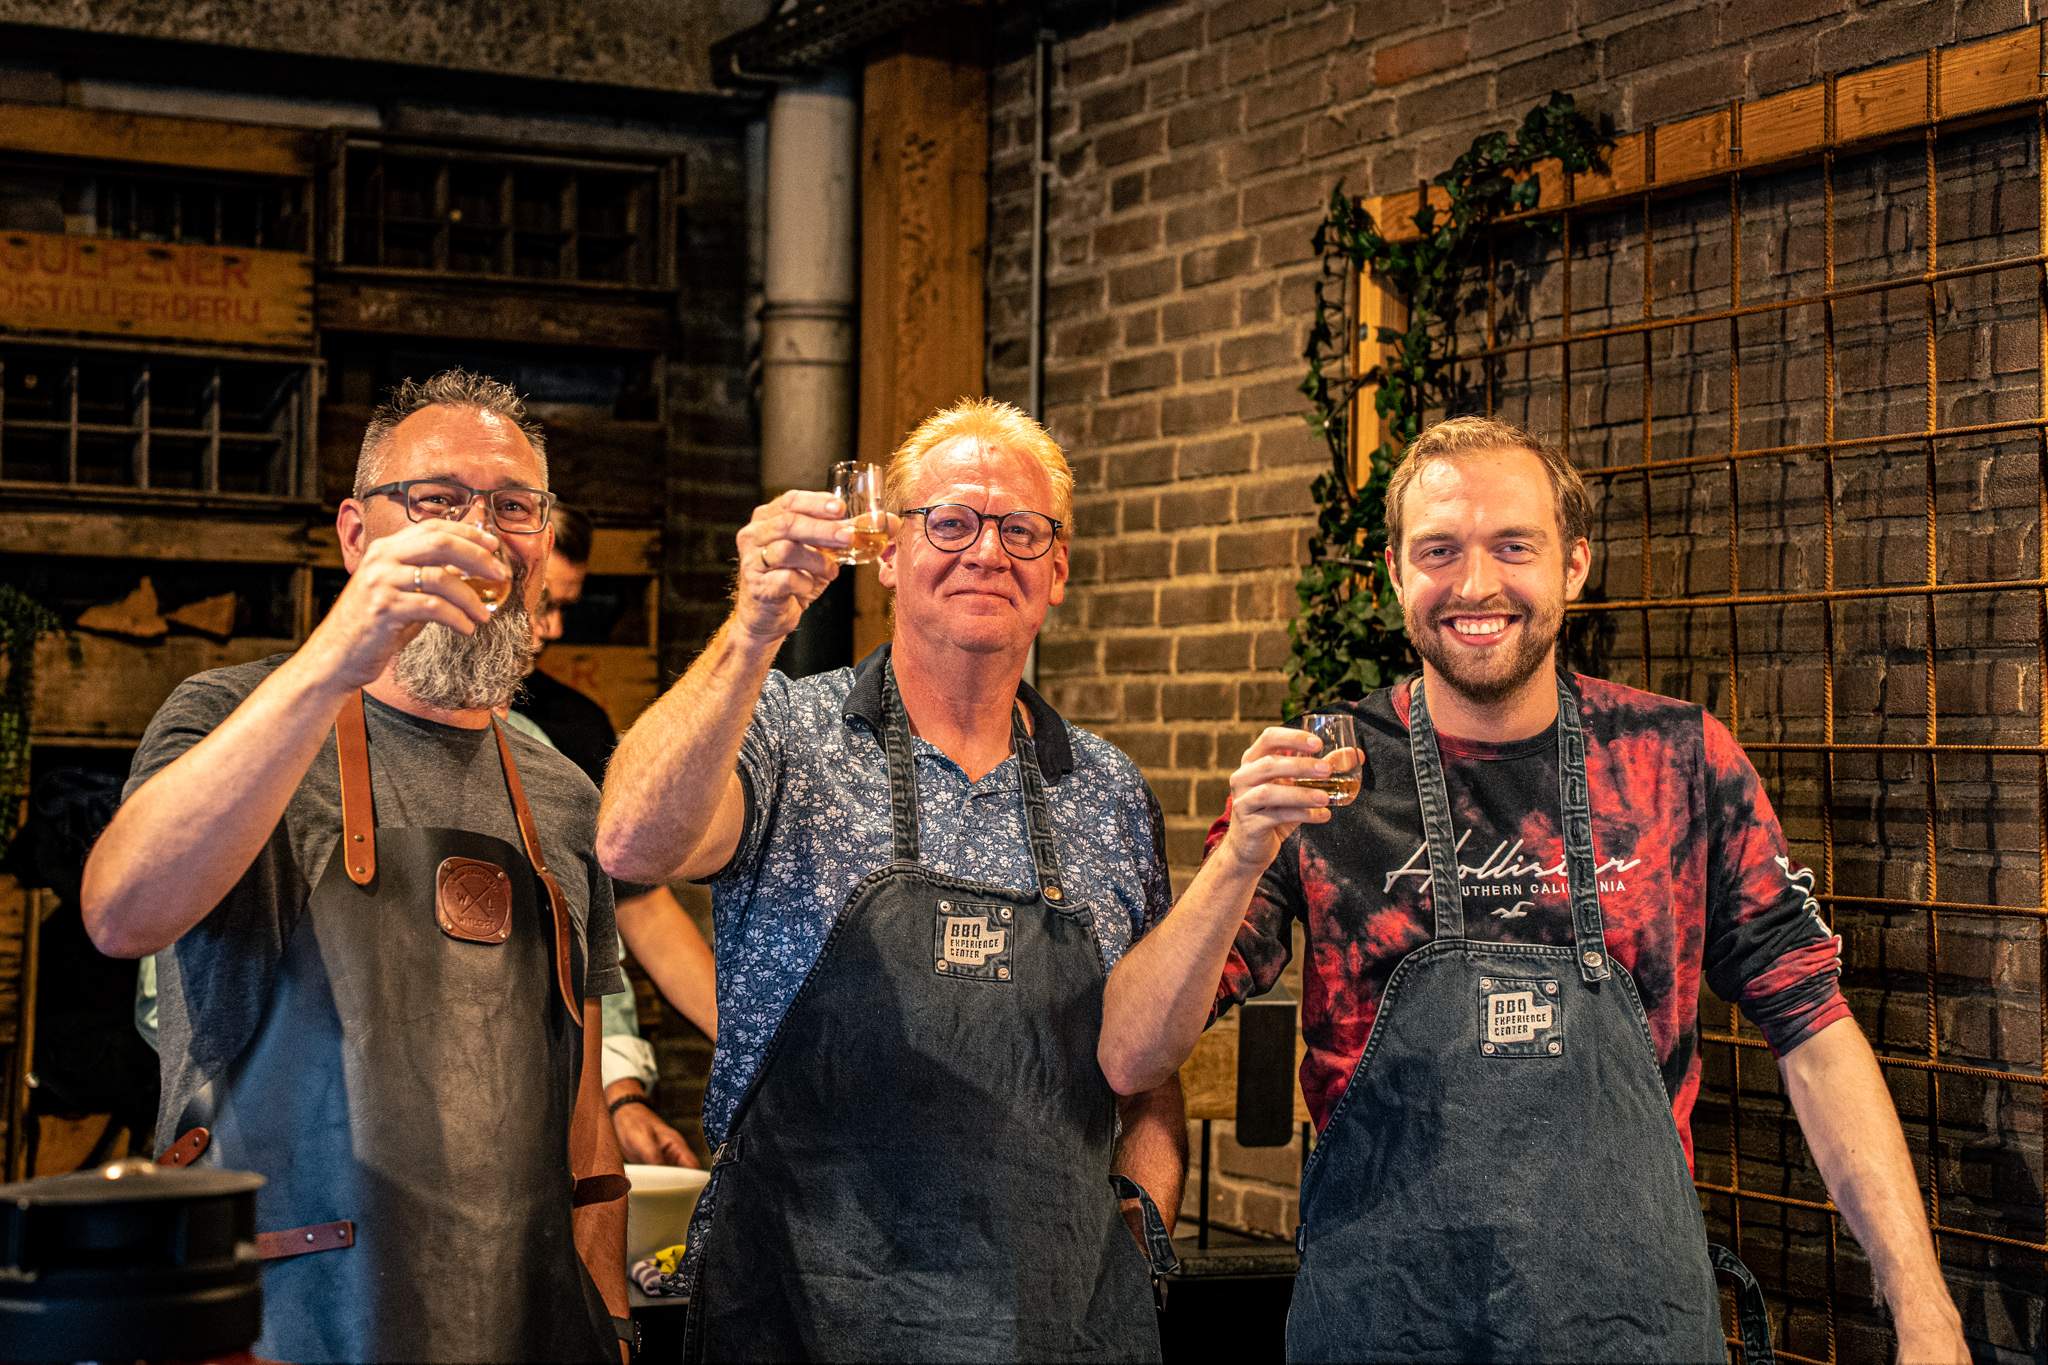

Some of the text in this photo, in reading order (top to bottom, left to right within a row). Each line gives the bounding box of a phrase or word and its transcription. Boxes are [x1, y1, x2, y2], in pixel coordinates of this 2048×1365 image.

[1462, 880, 1626, 896] UTHERN CALINIA
[951, 924, 980, 939] BBQ
[950, 939, 1000, 949] EXPERIENCE
[950, 948, 980, 959] CENTER
[1495, 999, 1526, 1014] BBQ
[1494, 1013, 1547, 1026] EXPERIENCE
[1494, 1025, 1528, 1036] CENTER
